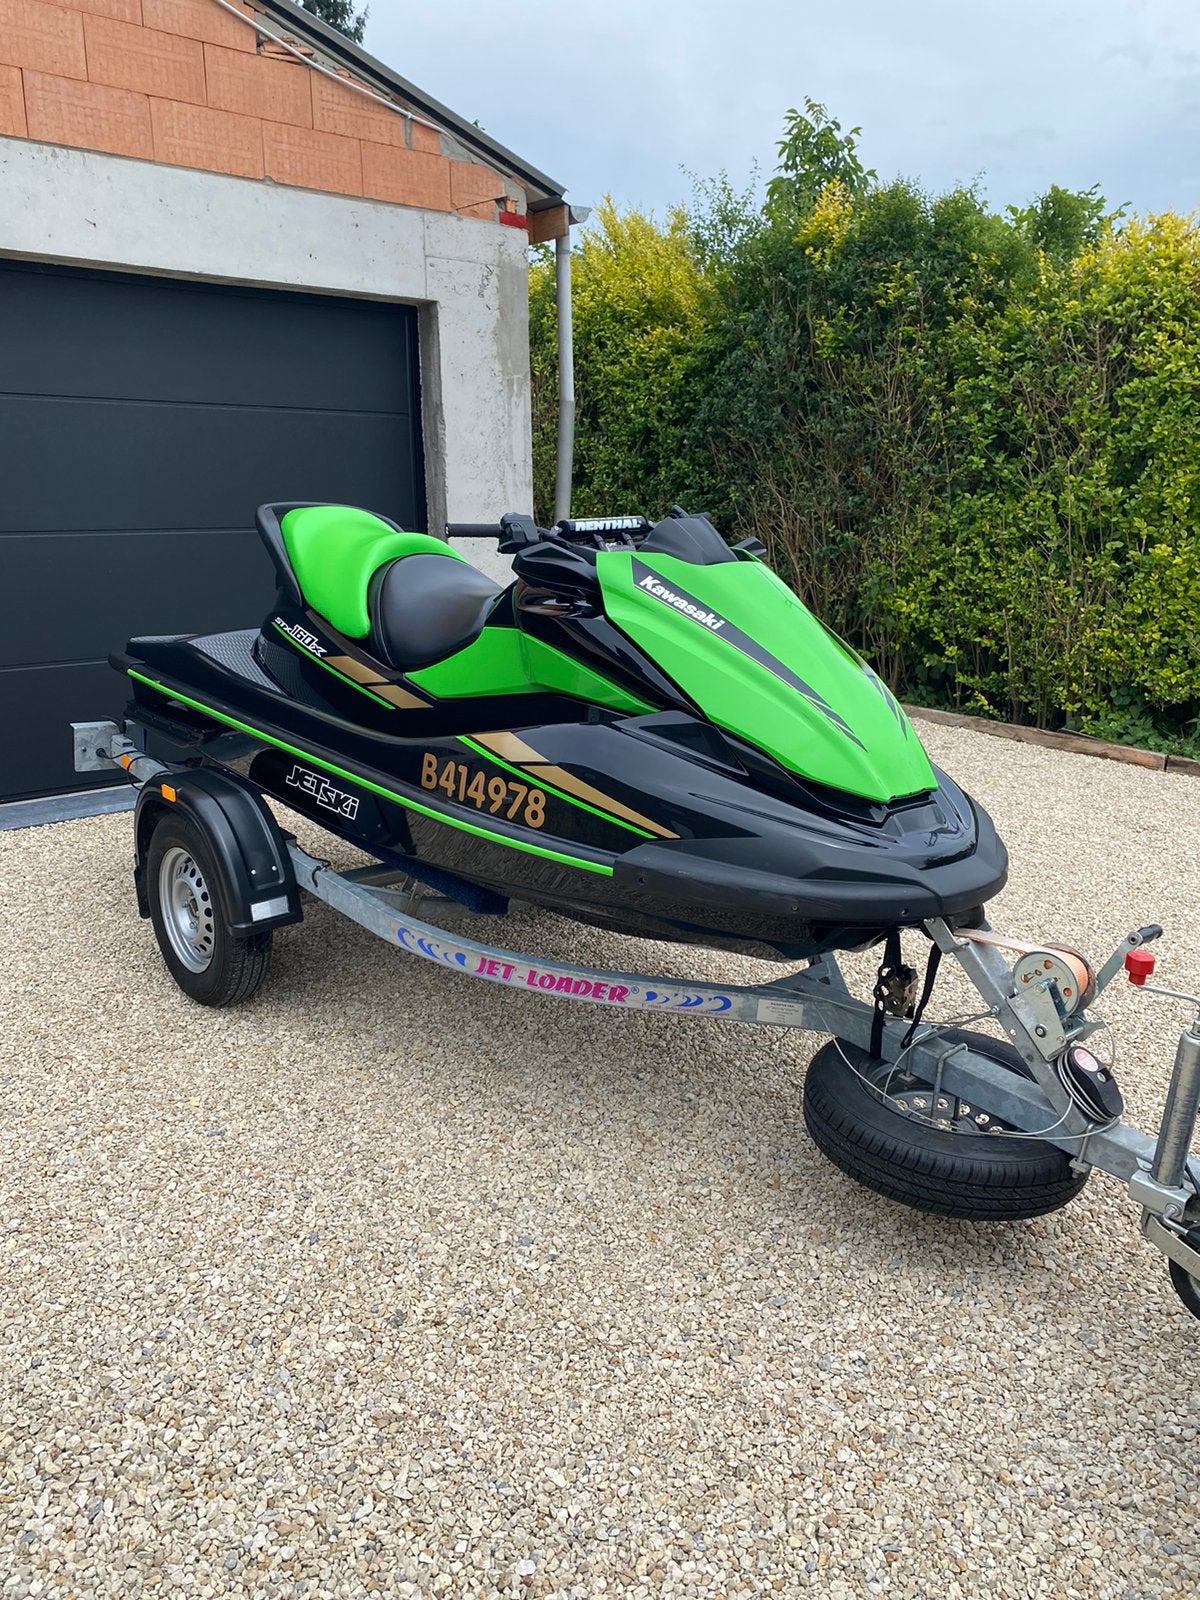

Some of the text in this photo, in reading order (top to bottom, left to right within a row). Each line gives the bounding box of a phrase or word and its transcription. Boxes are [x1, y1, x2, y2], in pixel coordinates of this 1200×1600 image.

[575, 519, 641, 532] RENTHAL
[639, 575, 726, 630] Kawasaki
[421, 752, 546, 828] B414978
